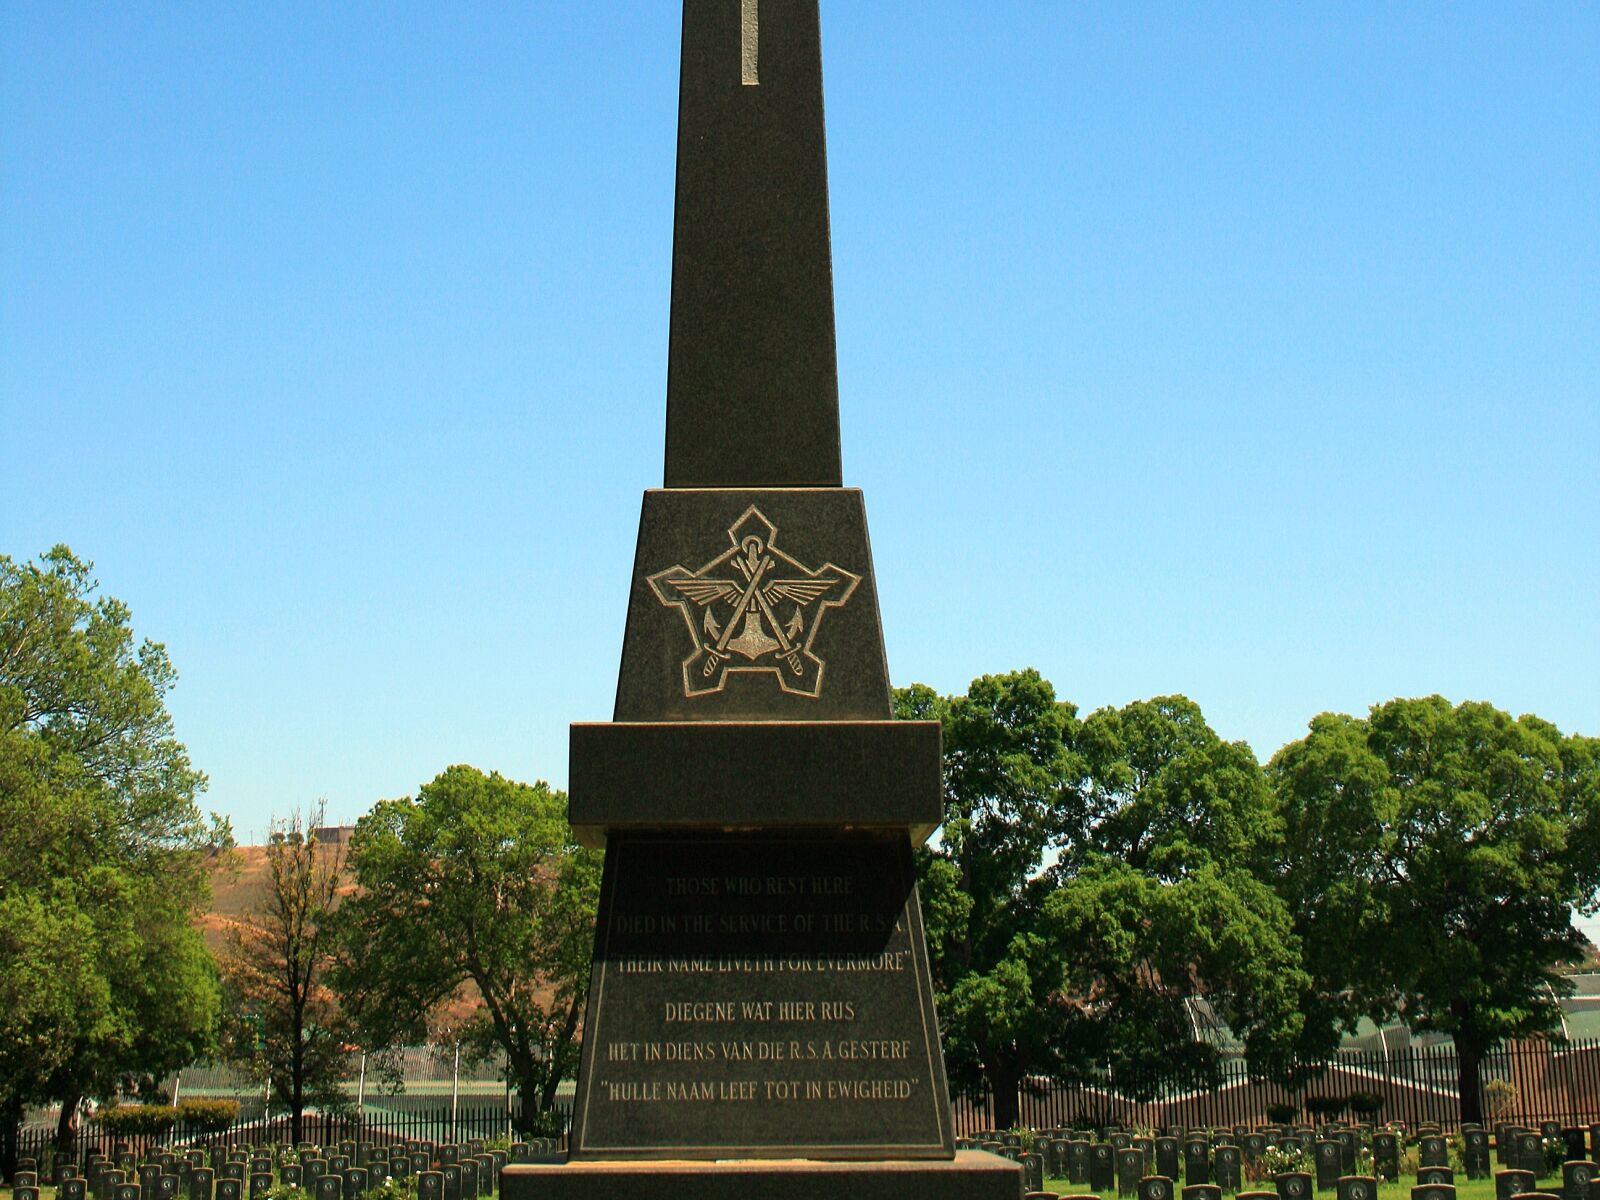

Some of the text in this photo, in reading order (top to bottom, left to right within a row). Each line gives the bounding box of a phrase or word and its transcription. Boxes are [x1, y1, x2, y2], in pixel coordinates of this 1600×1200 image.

[667, 876, 853, 895] THOSE WHO REST HERE
[616, 914, 656, 933] DIED
[661, 914, 676, 933] IN
[683, 914, 713, 933] THE
[719, 914, 787, 933] SERVICE
[794, 913, 816, 932] OF
[823, 913, 852, 932] THE
[669, 953, 714, 972] NAME
[719, 953, 773, 972] LIVETH
[779, 953, 812, 972] FOR
[665, 1001, 855, 1021] DIEGENE WAT HIER RUS
[609, 1042, 639, 1061] HET
[645, 1042, 660, 1061] IN
[666, 1042, 715, 1061] DIENS
[721, 1041, 752, 1060] VAN
[759, 1041, 784, 1060] DIE
[838, 1040, 911, 1060] GESTERF
[667, 1081, 714, 1100] NAAM
[720, 1081, 757, 1100] LEEF
[764, 1081, 801, 1100] TOT
[806, 1081, 821, 1099] IN
